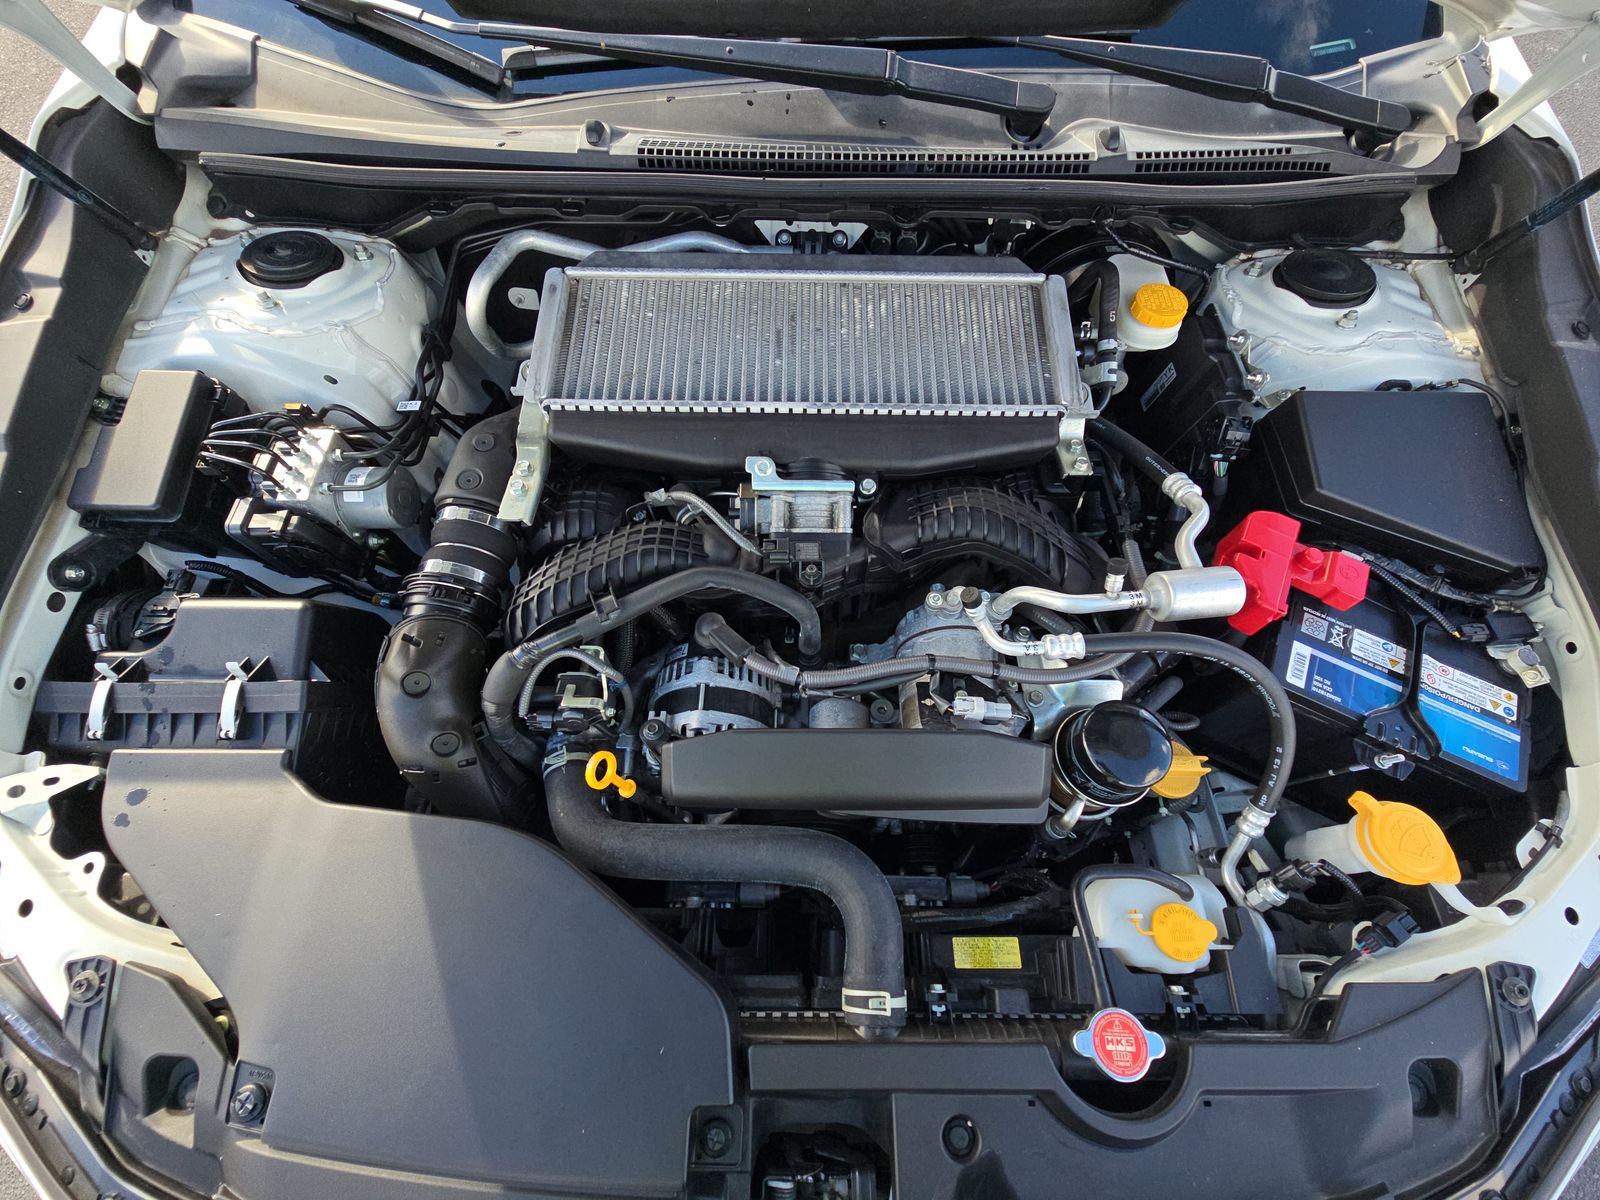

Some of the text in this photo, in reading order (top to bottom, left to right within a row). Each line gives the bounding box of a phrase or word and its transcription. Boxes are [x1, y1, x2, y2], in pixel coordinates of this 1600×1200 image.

[1110, 311, 1116, 322] 5
[1259, 795, 1268, 806] HP
[1269, 774, 1277, 787] AJ
[1273, 759, 1281, 769] 13
[1106, 1037, 1134, 1047] HKS
